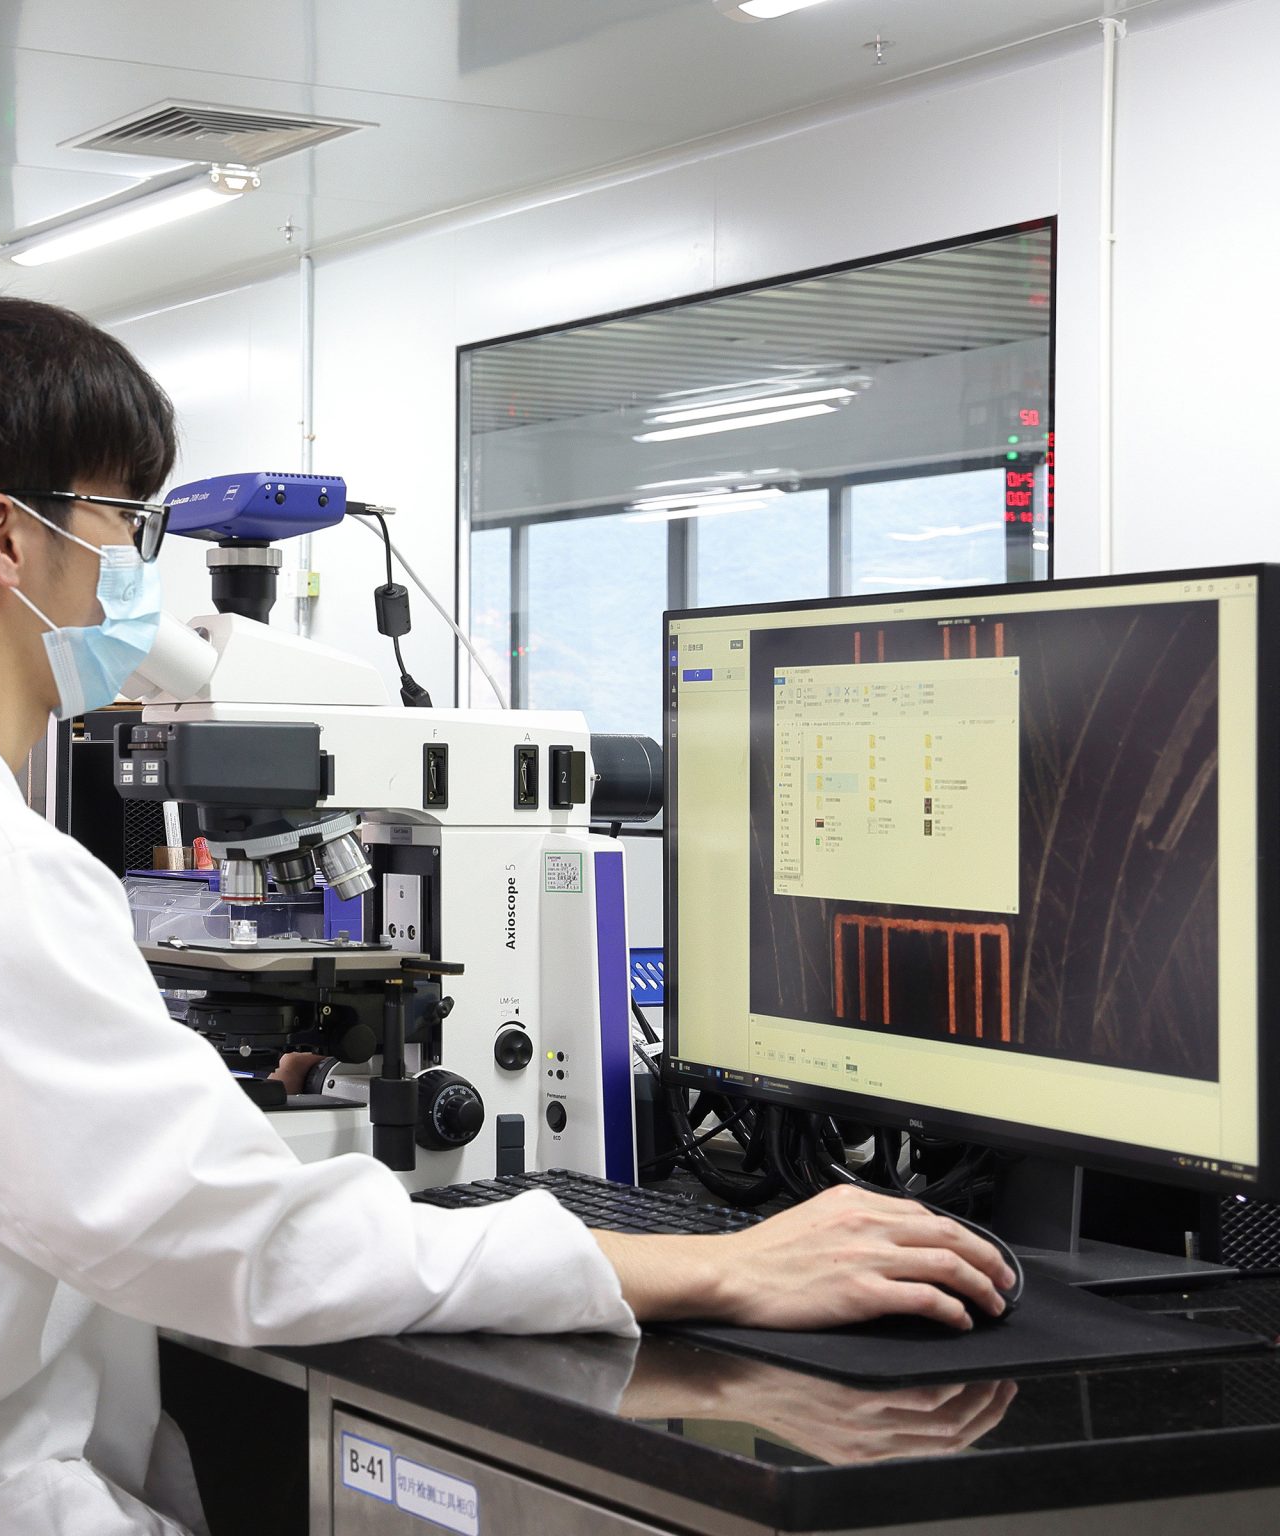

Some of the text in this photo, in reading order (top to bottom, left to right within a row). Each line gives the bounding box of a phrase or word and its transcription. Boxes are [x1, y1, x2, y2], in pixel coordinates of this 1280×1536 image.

[432, 728, 438, 738] F
[523, 732, 531, 741] A
[561, 771, 567, 784] 2
[505, 877, 519, 950] Axioscope
[499, 997, 520, 1005] LM-Set
[546, 1092, 567, 1100] Permanent
[909, 1118, 924, 1129] DELL
[350, 1448, 384, 1483] B-41
